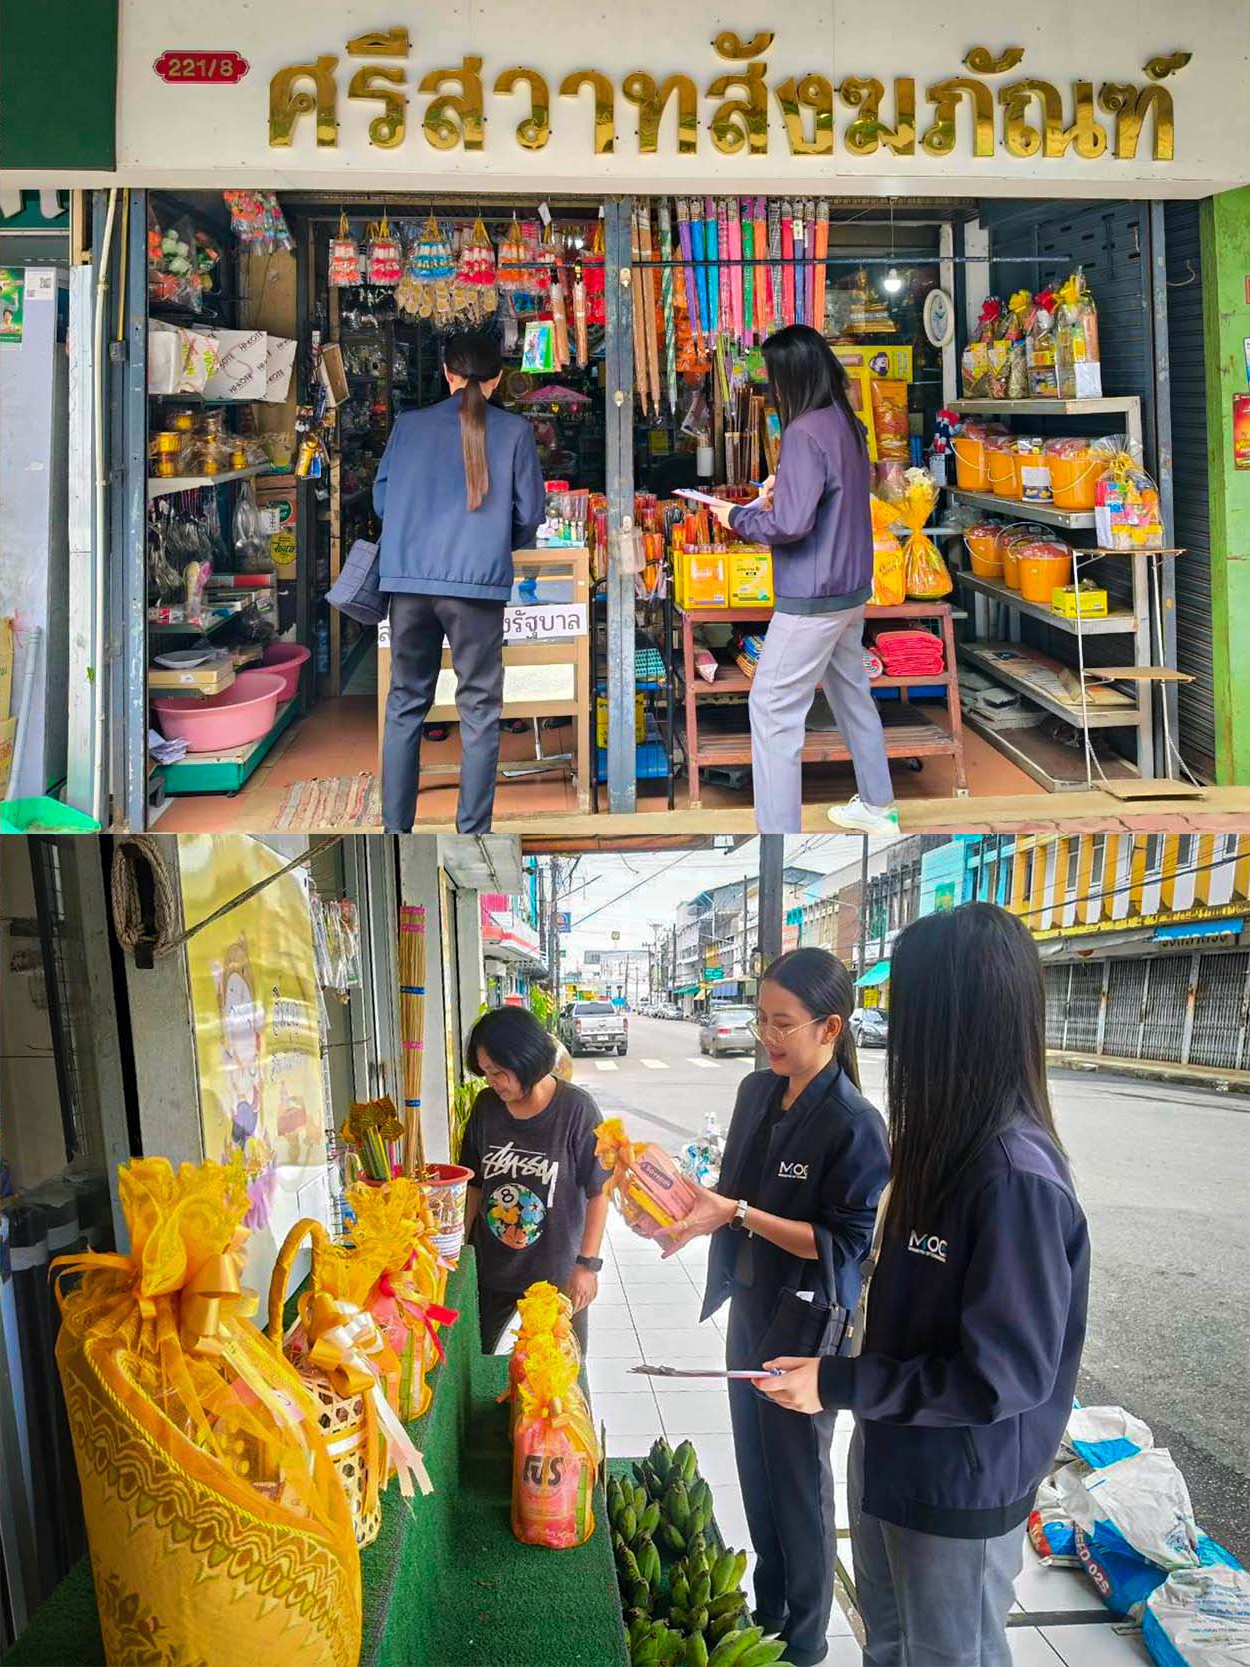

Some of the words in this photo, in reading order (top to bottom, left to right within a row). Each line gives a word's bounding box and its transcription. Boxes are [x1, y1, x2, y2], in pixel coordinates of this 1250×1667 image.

[168, 58, 234, 78] 221/8
[267, 25, 1193, 161] ศรีสวาทสังฆภัณฑ์
[501, 1188, 515, 1203] 8
